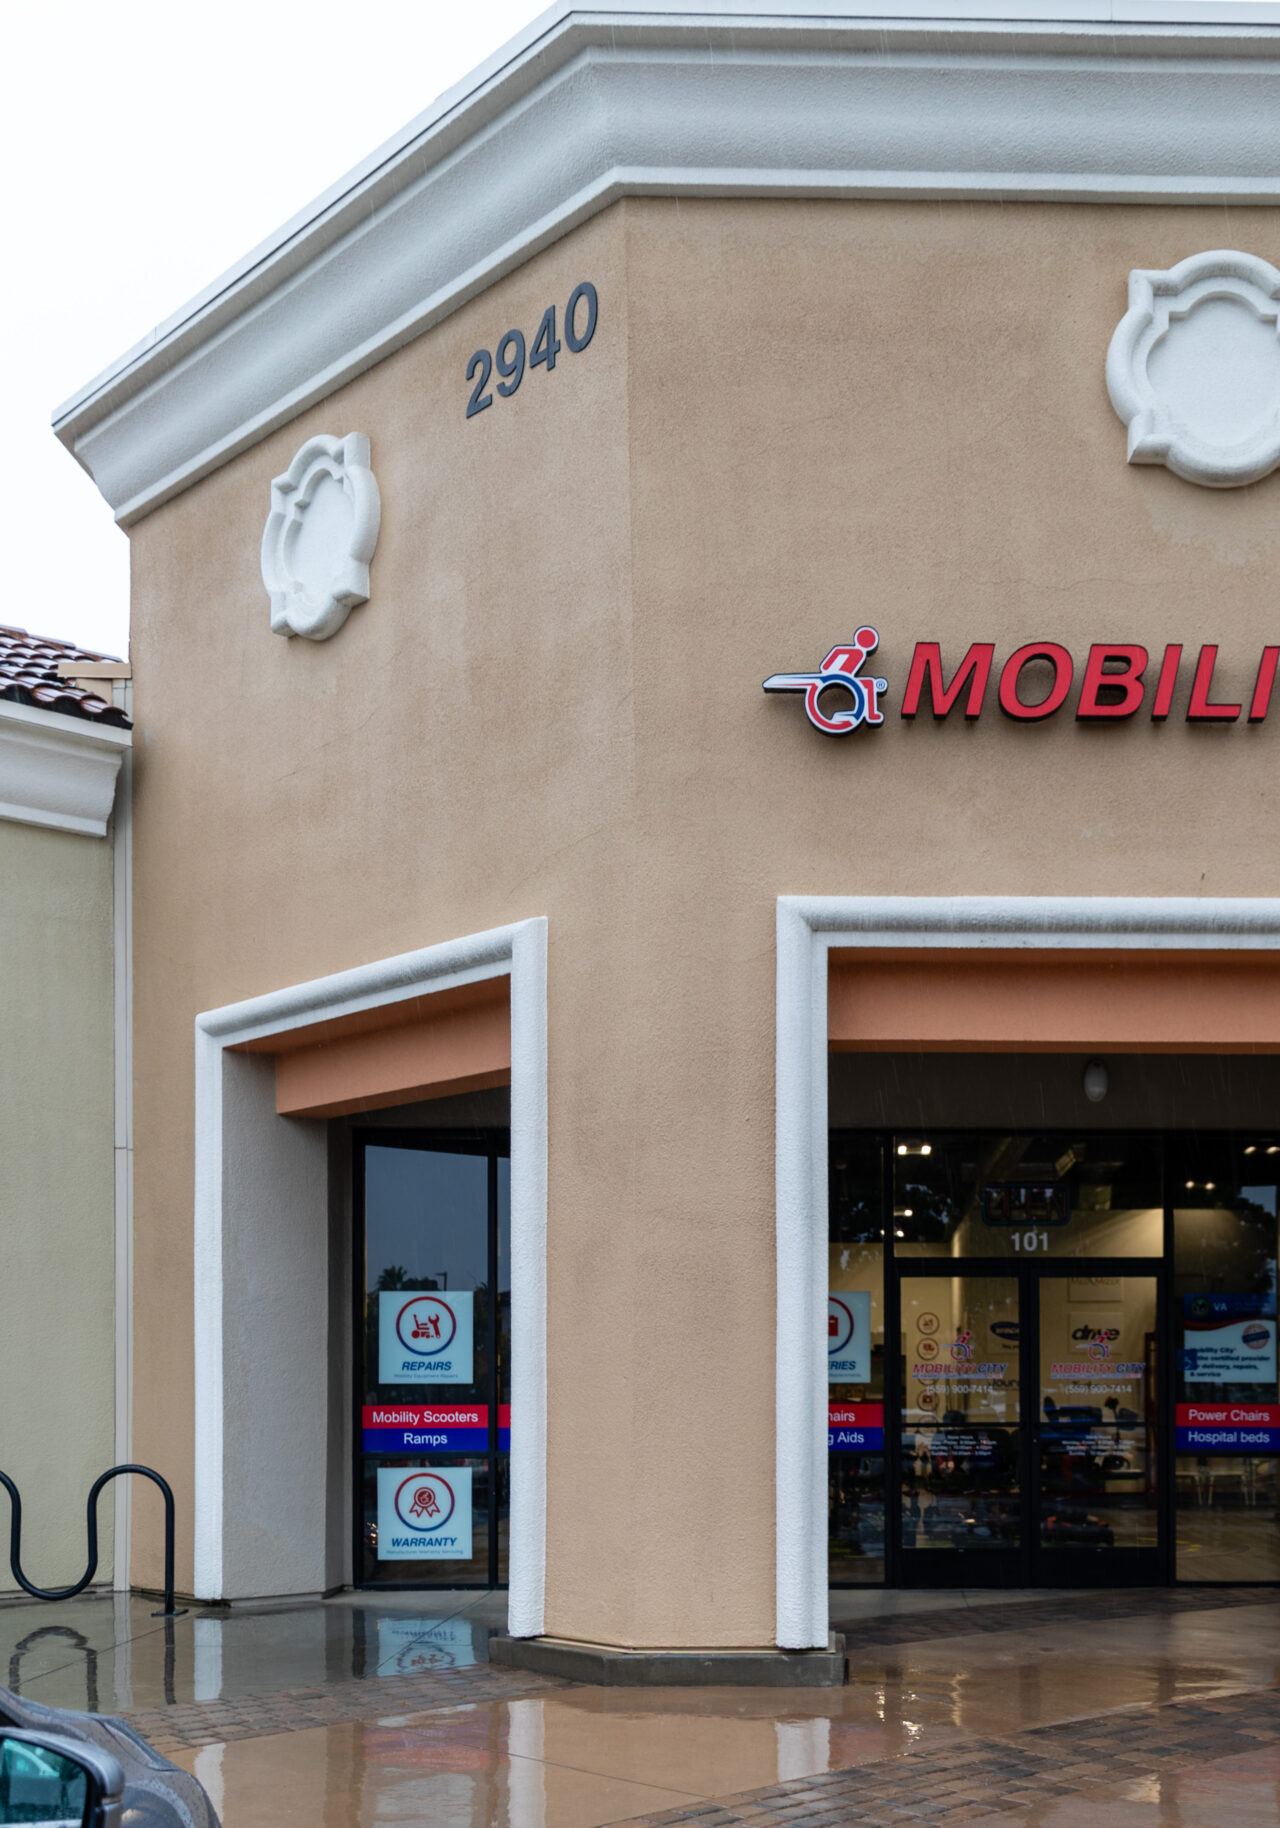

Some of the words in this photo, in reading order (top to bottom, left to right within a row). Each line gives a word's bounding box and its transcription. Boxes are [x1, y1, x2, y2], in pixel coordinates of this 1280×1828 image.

[466, 281, 598, 419] 2940
[1010, 1231, 1049, 1252] 101
[402, 1361, 451, 1371] REPAIRS
[913, 1363, 976, 1373] MOBILITY
[977, 1362, 1008, 1373] CITY
[1051, 1363, 1114, 1373] MOBILITY
[1115, 1362, 1147, 1373] CITY
[372, 1411, 420, 1426] Mobility
[423, 1411, 479, 1423] Scooters
[1188, 1409, 1227, 1421] Power
[1229, 1409, 1270, 1422] Chairs
[403, 1432, 448, 1446] Ramps
[837, 1431, 865, 1443] Aids
[1187, 1430, 1238, 1445] Hospital
[1240, 1430, 1270, 1443] beds
[392, 1537, 457, 1547] WARRANTY
